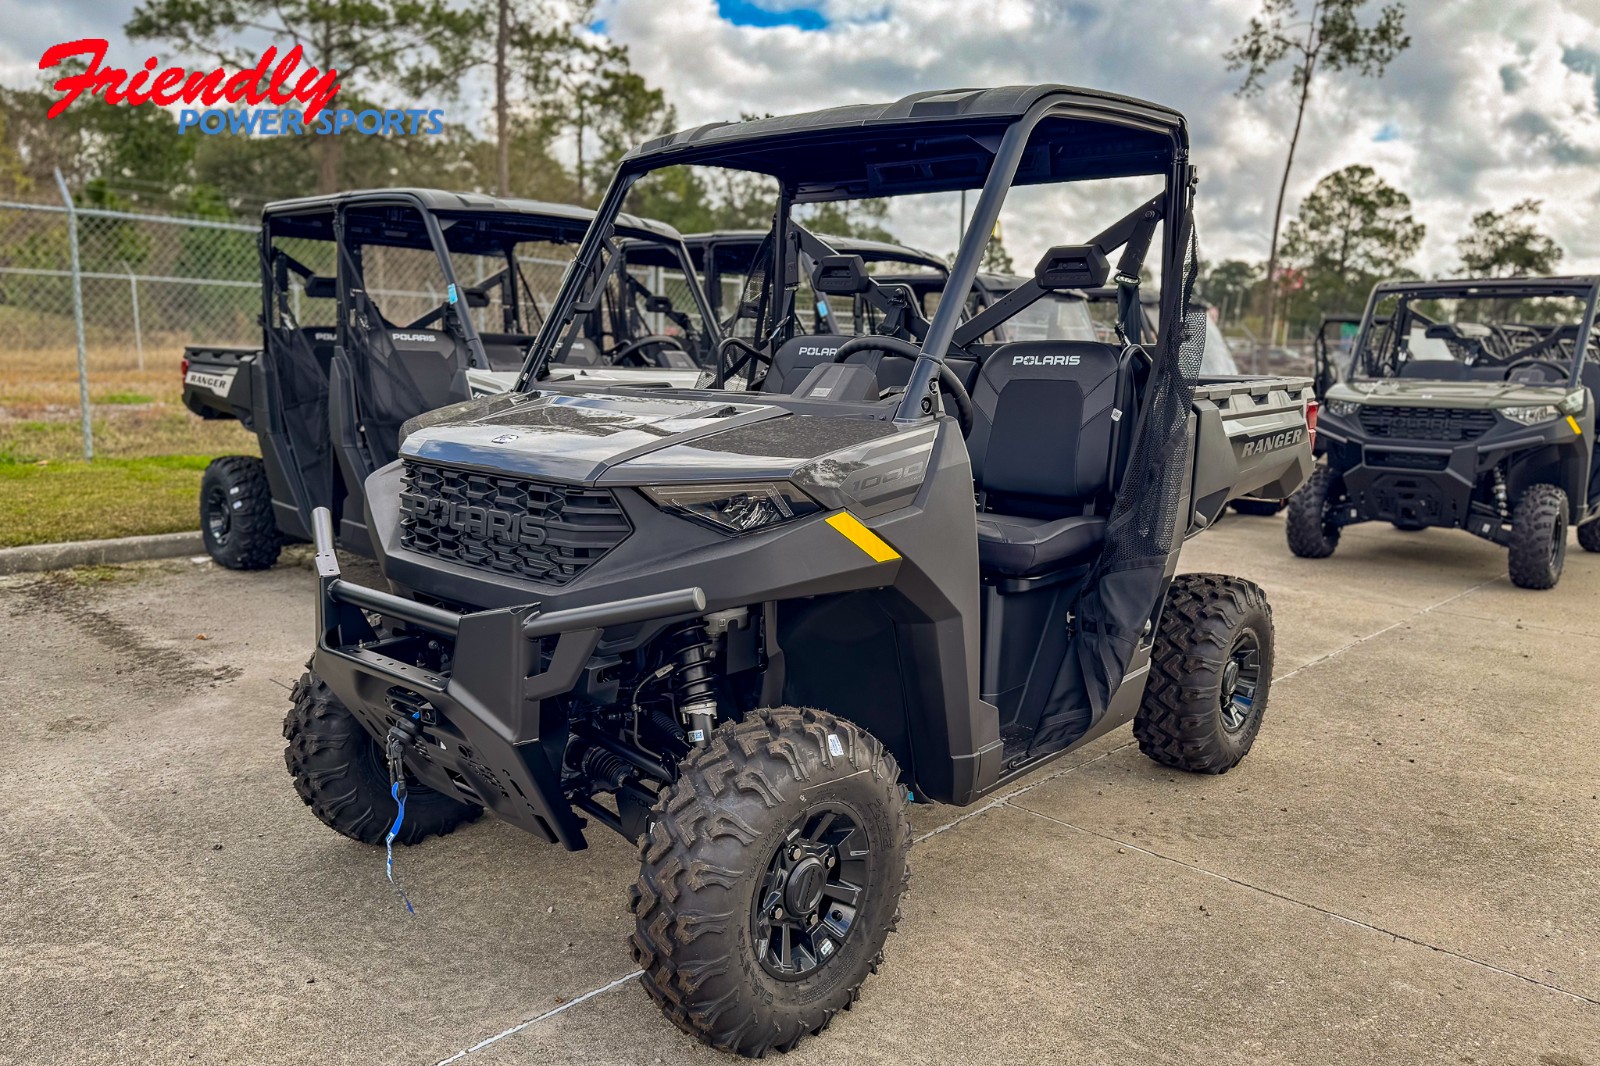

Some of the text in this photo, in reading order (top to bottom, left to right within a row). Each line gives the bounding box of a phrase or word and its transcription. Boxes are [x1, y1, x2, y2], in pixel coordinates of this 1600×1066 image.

[391, 332, 437, 343] POLARIS
[1012, 355, 1081, 366] POLARIS
[190, 375, 227, 389] RANGER
[1241, 428, 1303, 459] RANGER
[410, 493, 549, 547] POLARIS
